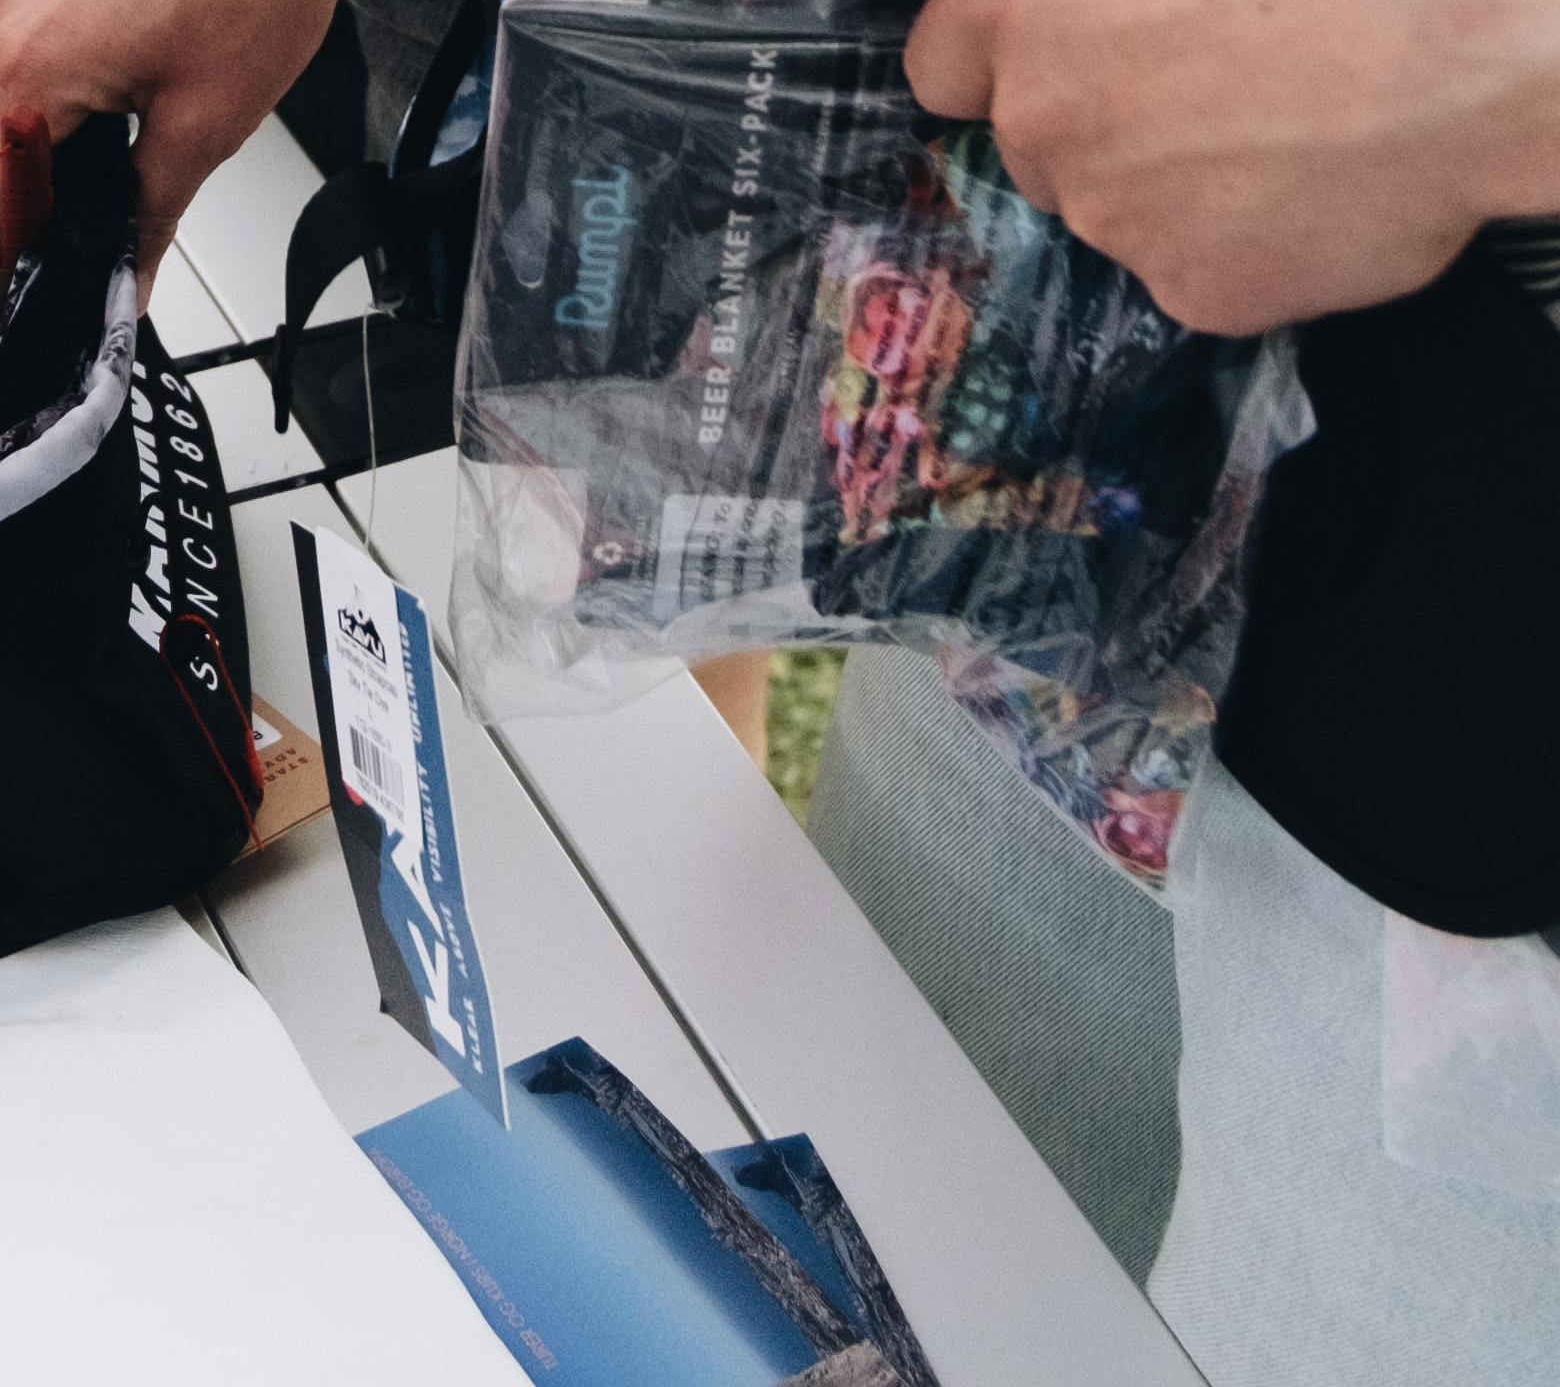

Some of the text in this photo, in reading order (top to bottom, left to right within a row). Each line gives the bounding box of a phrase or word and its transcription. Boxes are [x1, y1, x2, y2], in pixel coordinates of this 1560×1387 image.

[698, 48, 780, 445] BEER BLANKET SIX-PACK
[339, 610, 386, 664] KAVU
[415, 763, 444, 883] VISIBILITY
[439, 900, 470, 980] ABOVE
[406, 1187, 432, 1212] OG
[427, 1212, 473, 1260] NORGE
[498, 1301, 526, 1328] OG
